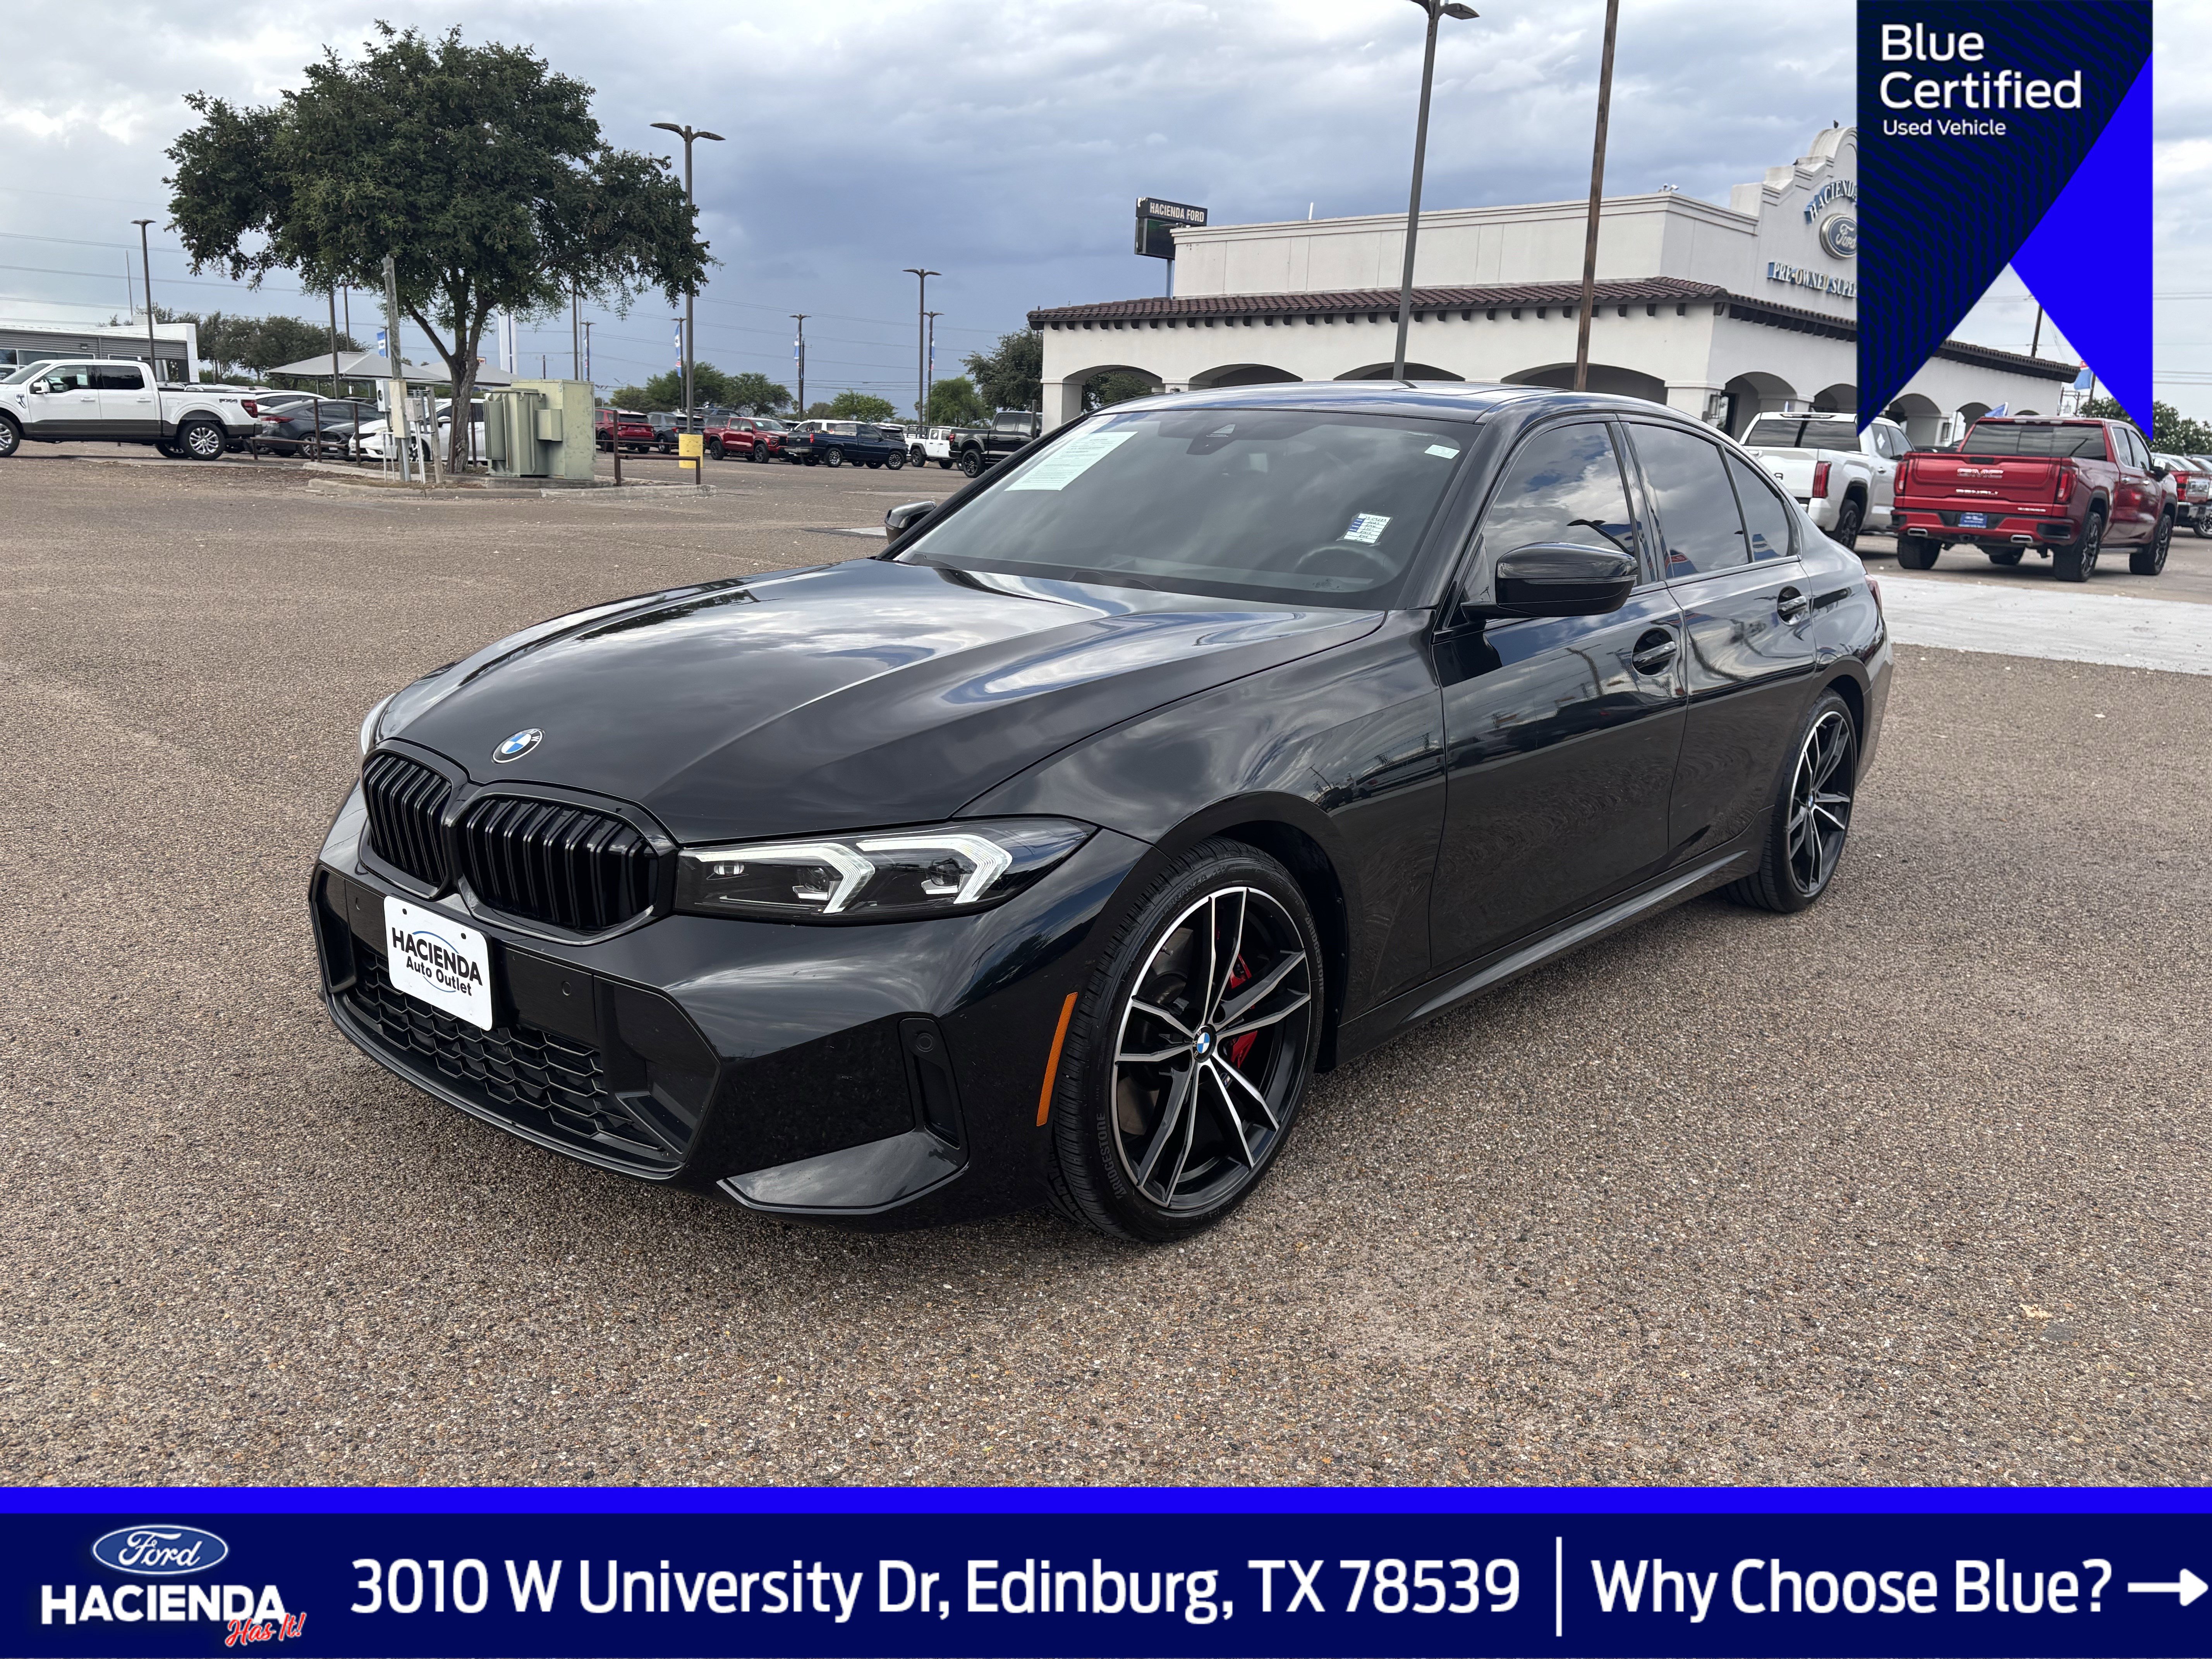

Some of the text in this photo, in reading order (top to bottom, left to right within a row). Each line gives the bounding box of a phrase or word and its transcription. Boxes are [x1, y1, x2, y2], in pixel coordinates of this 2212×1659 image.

[1150, 202, 1204, 222] HACIENDA FORD
[1957, 468, 2004, 479] GMC
[392, 927, 483, 986] HACIENDA
[406, 956, 472, 996] Auto Outlet
